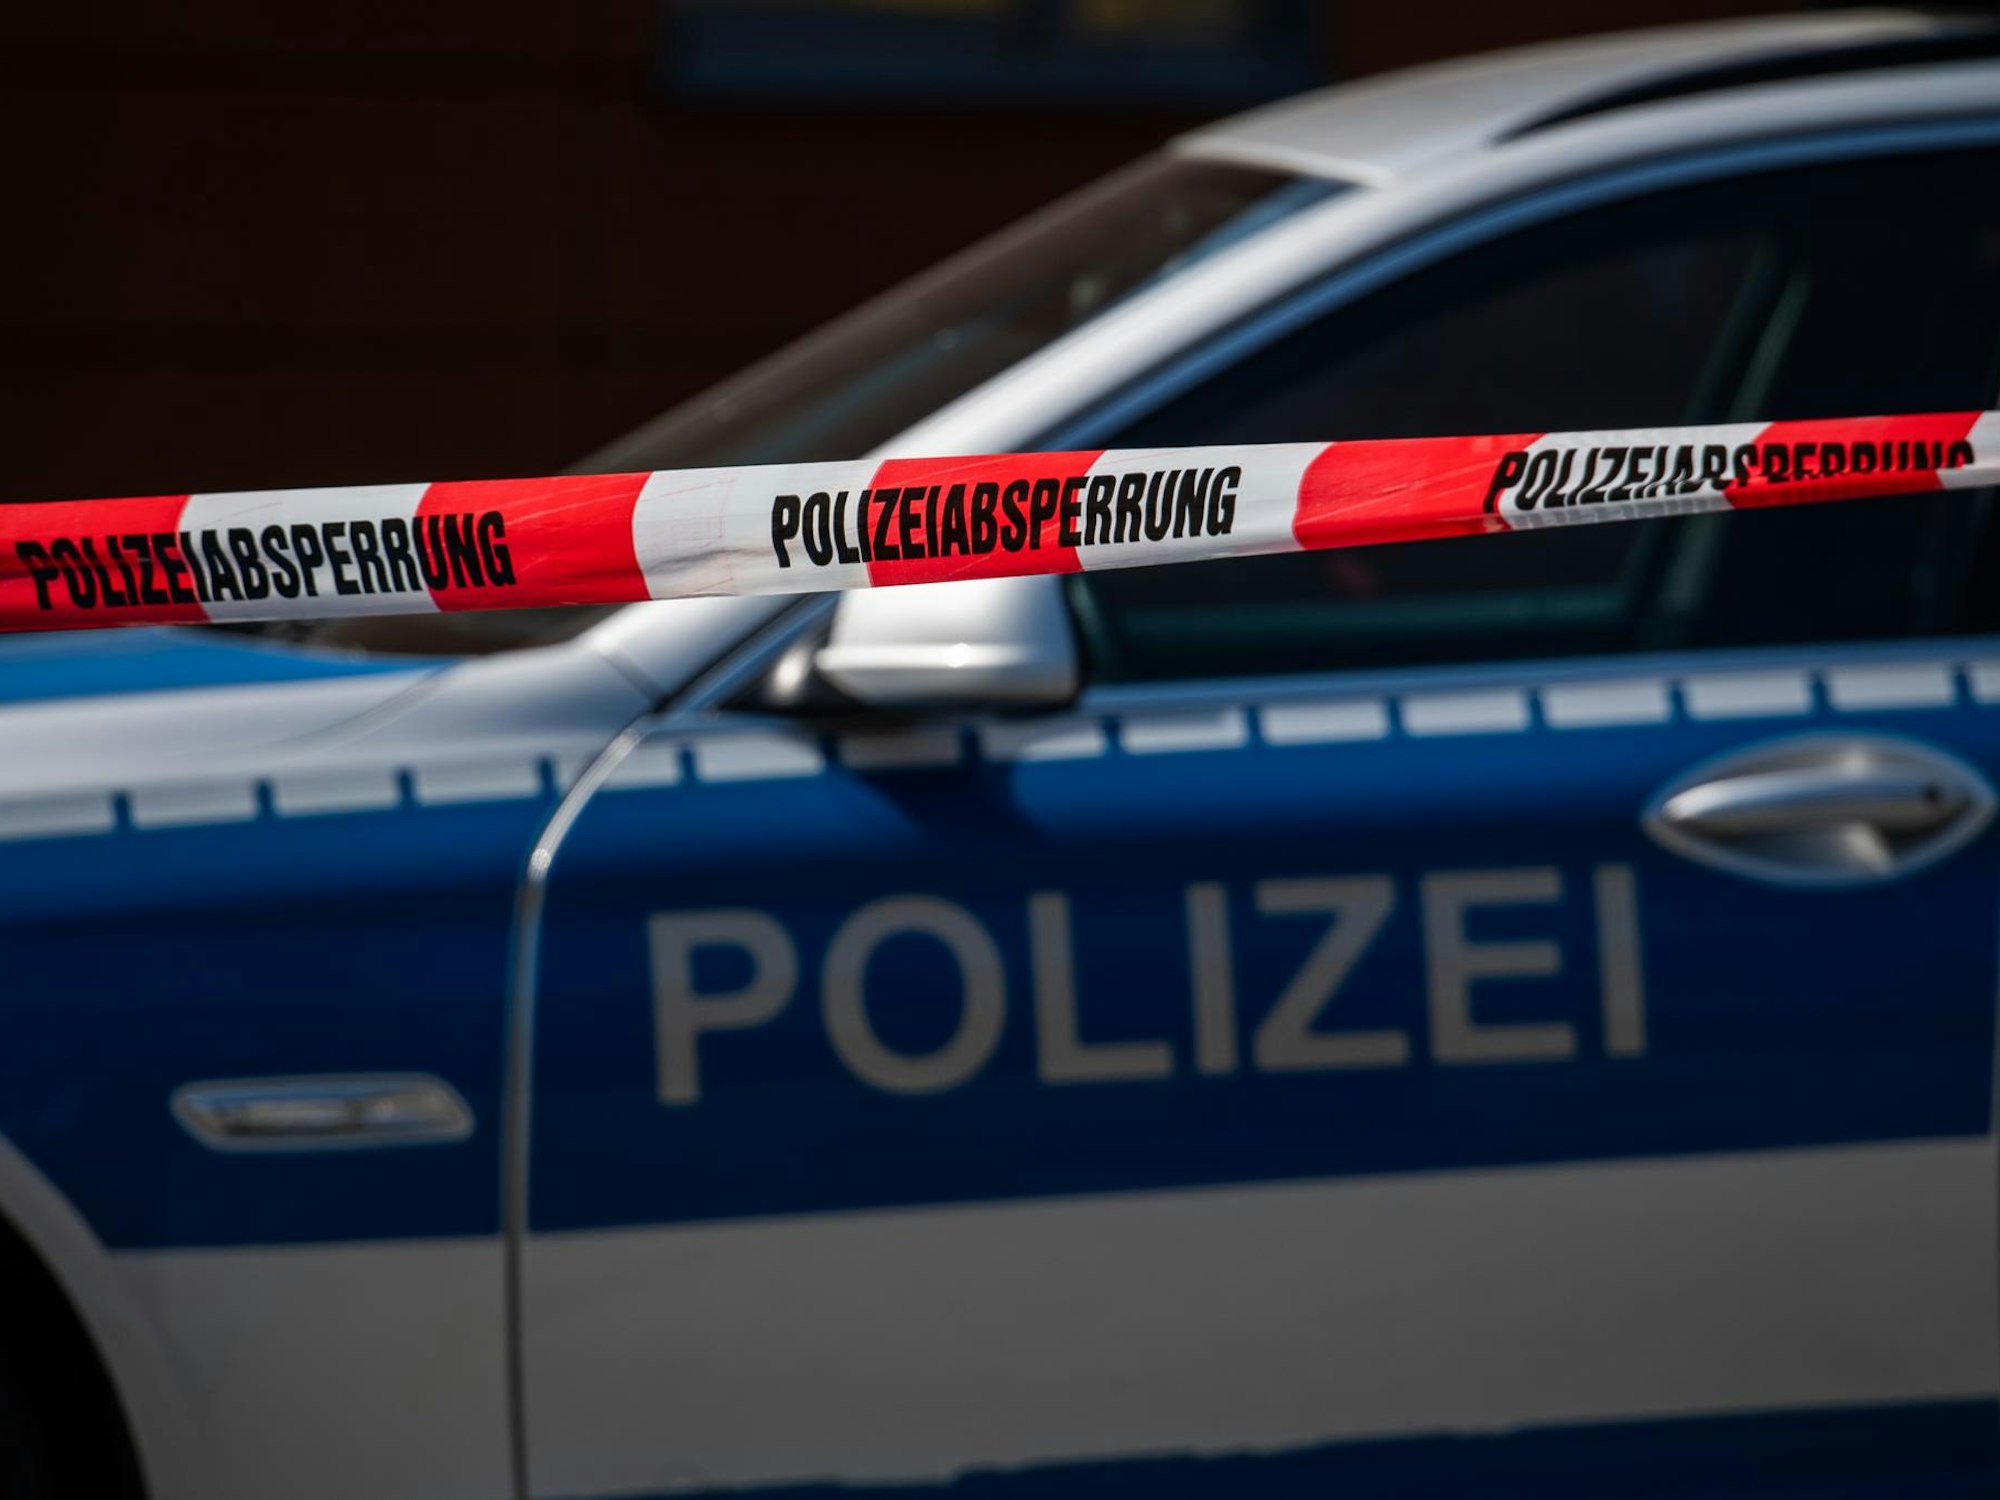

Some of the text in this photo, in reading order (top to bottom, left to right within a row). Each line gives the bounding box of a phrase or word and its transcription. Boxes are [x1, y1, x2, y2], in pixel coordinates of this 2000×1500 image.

[16, 511, 516, 611] POLIZEIABSPERRUNG
[771, 466, 1241, 568] POLIZEIABSPERRUNG
[648, 864, 1647, 1104] POLIZEI
